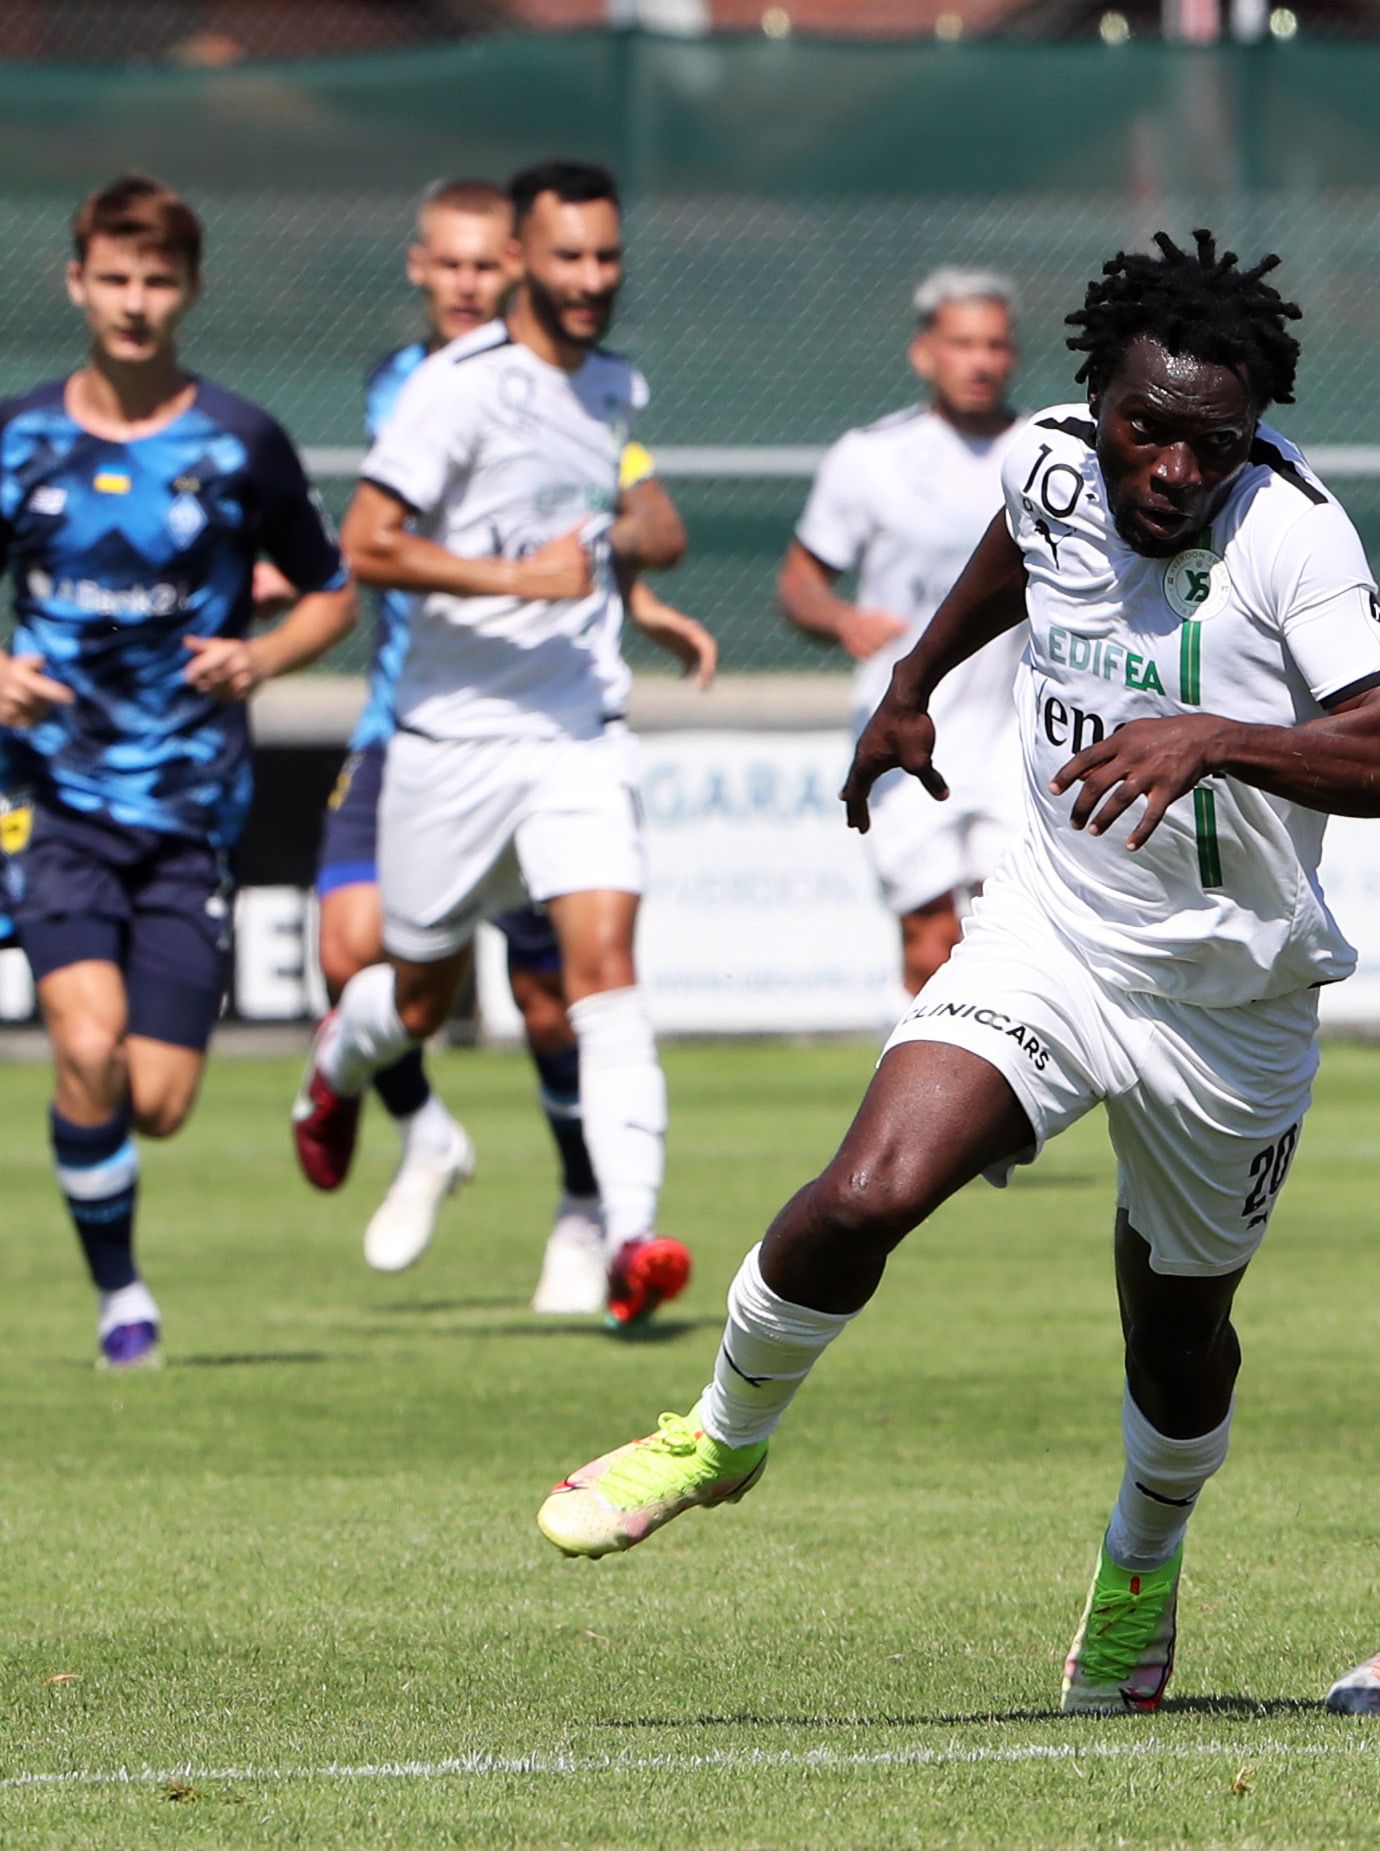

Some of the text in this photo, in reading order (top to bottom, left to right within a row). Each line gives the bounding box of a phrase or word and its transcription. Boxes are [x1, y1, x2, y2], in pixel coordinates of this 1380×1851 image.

[1023, 444, 1085, 518] 10
[1049, 627, 1166, 696] EDIFEA
[640, 760, 850, 828] GARA
[1241, 1123, 1298, 1218] 20
